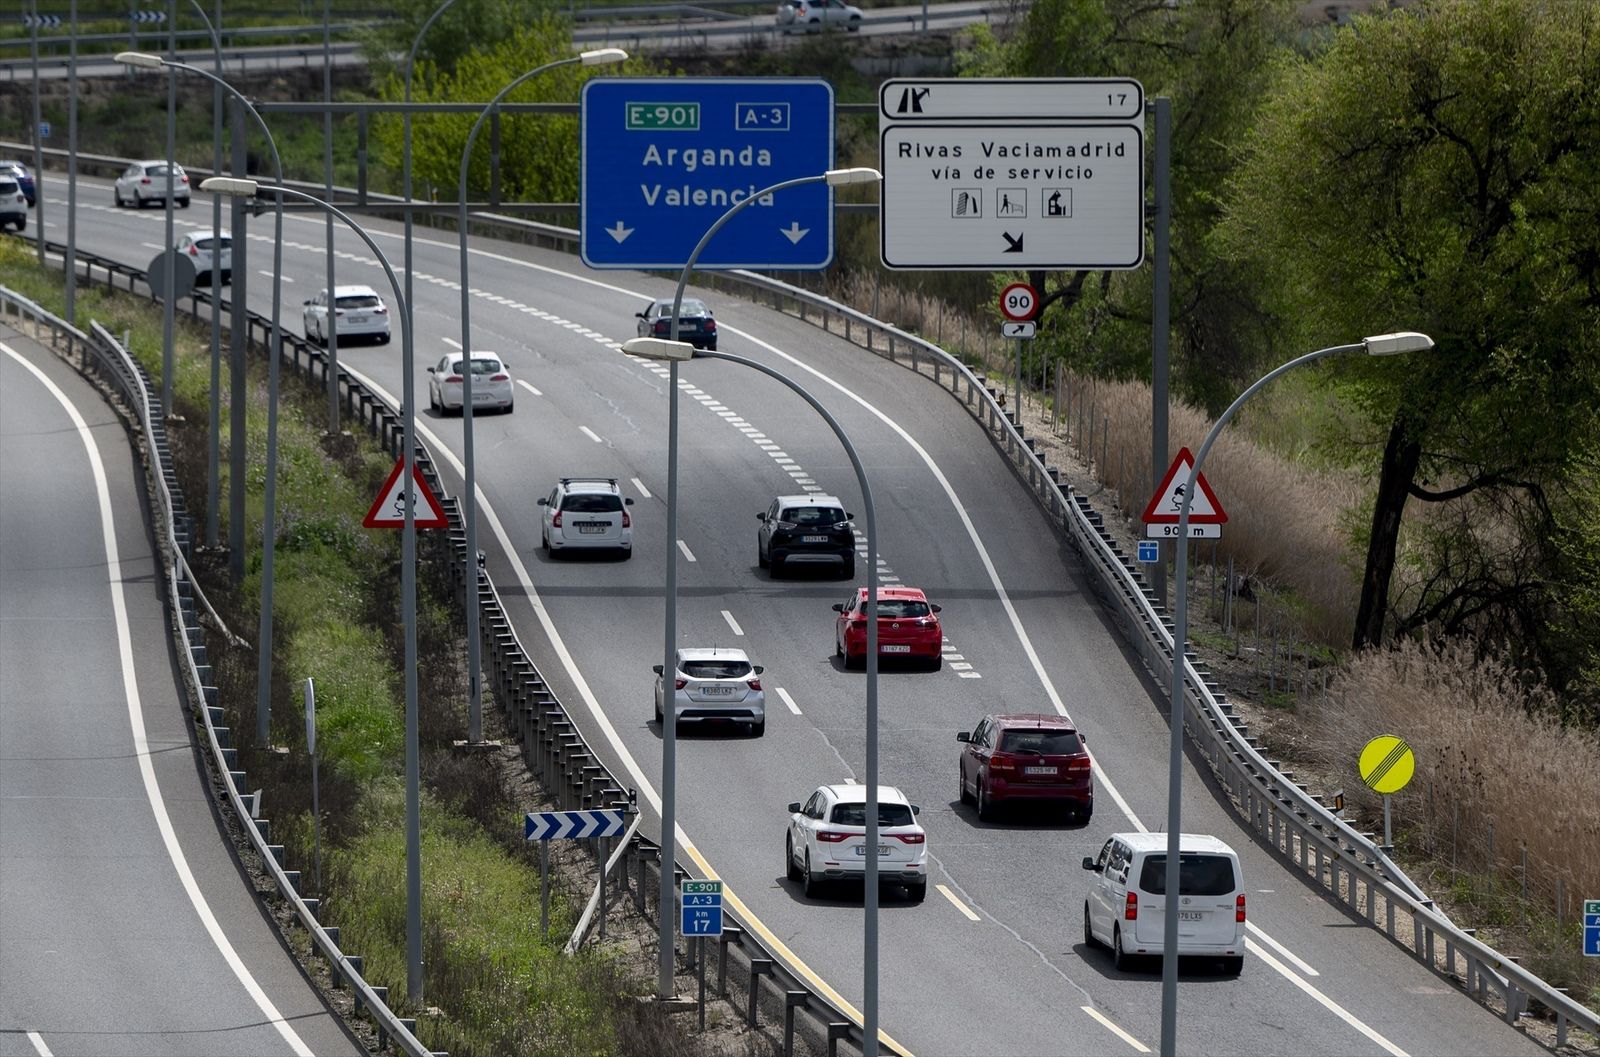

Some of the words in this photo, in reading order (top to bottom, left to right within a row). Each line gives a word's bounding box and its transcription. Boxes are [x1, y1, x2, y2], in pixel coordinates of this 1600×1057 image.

[1108, 94, 1127, 106] 17
[631, 107, 695, 125] E-901
[744, 109, 782, 124] A-3
[899, 142, 962, 157] Rivas
[981, 142, 1125, 157] Vaciamadrid
[642, 144, 772, 172] Arganda
[931, 165, 961, 180] vía
[973, 166, 995, 179] de
[1008, 165, 1093, 179] servicio
[640, 184, 774, 206] Valencia
[1009, 296, 1030, 309] 90
[1164, 526, 1184, 536] 90
[1193, 528, 1204, 536] m
[1146, 551, 1150, 559] 1
[687, 883, 717, 892] E-901
[692, 896, 712, 905] A-3
[693, 920, 710, 932] 17
